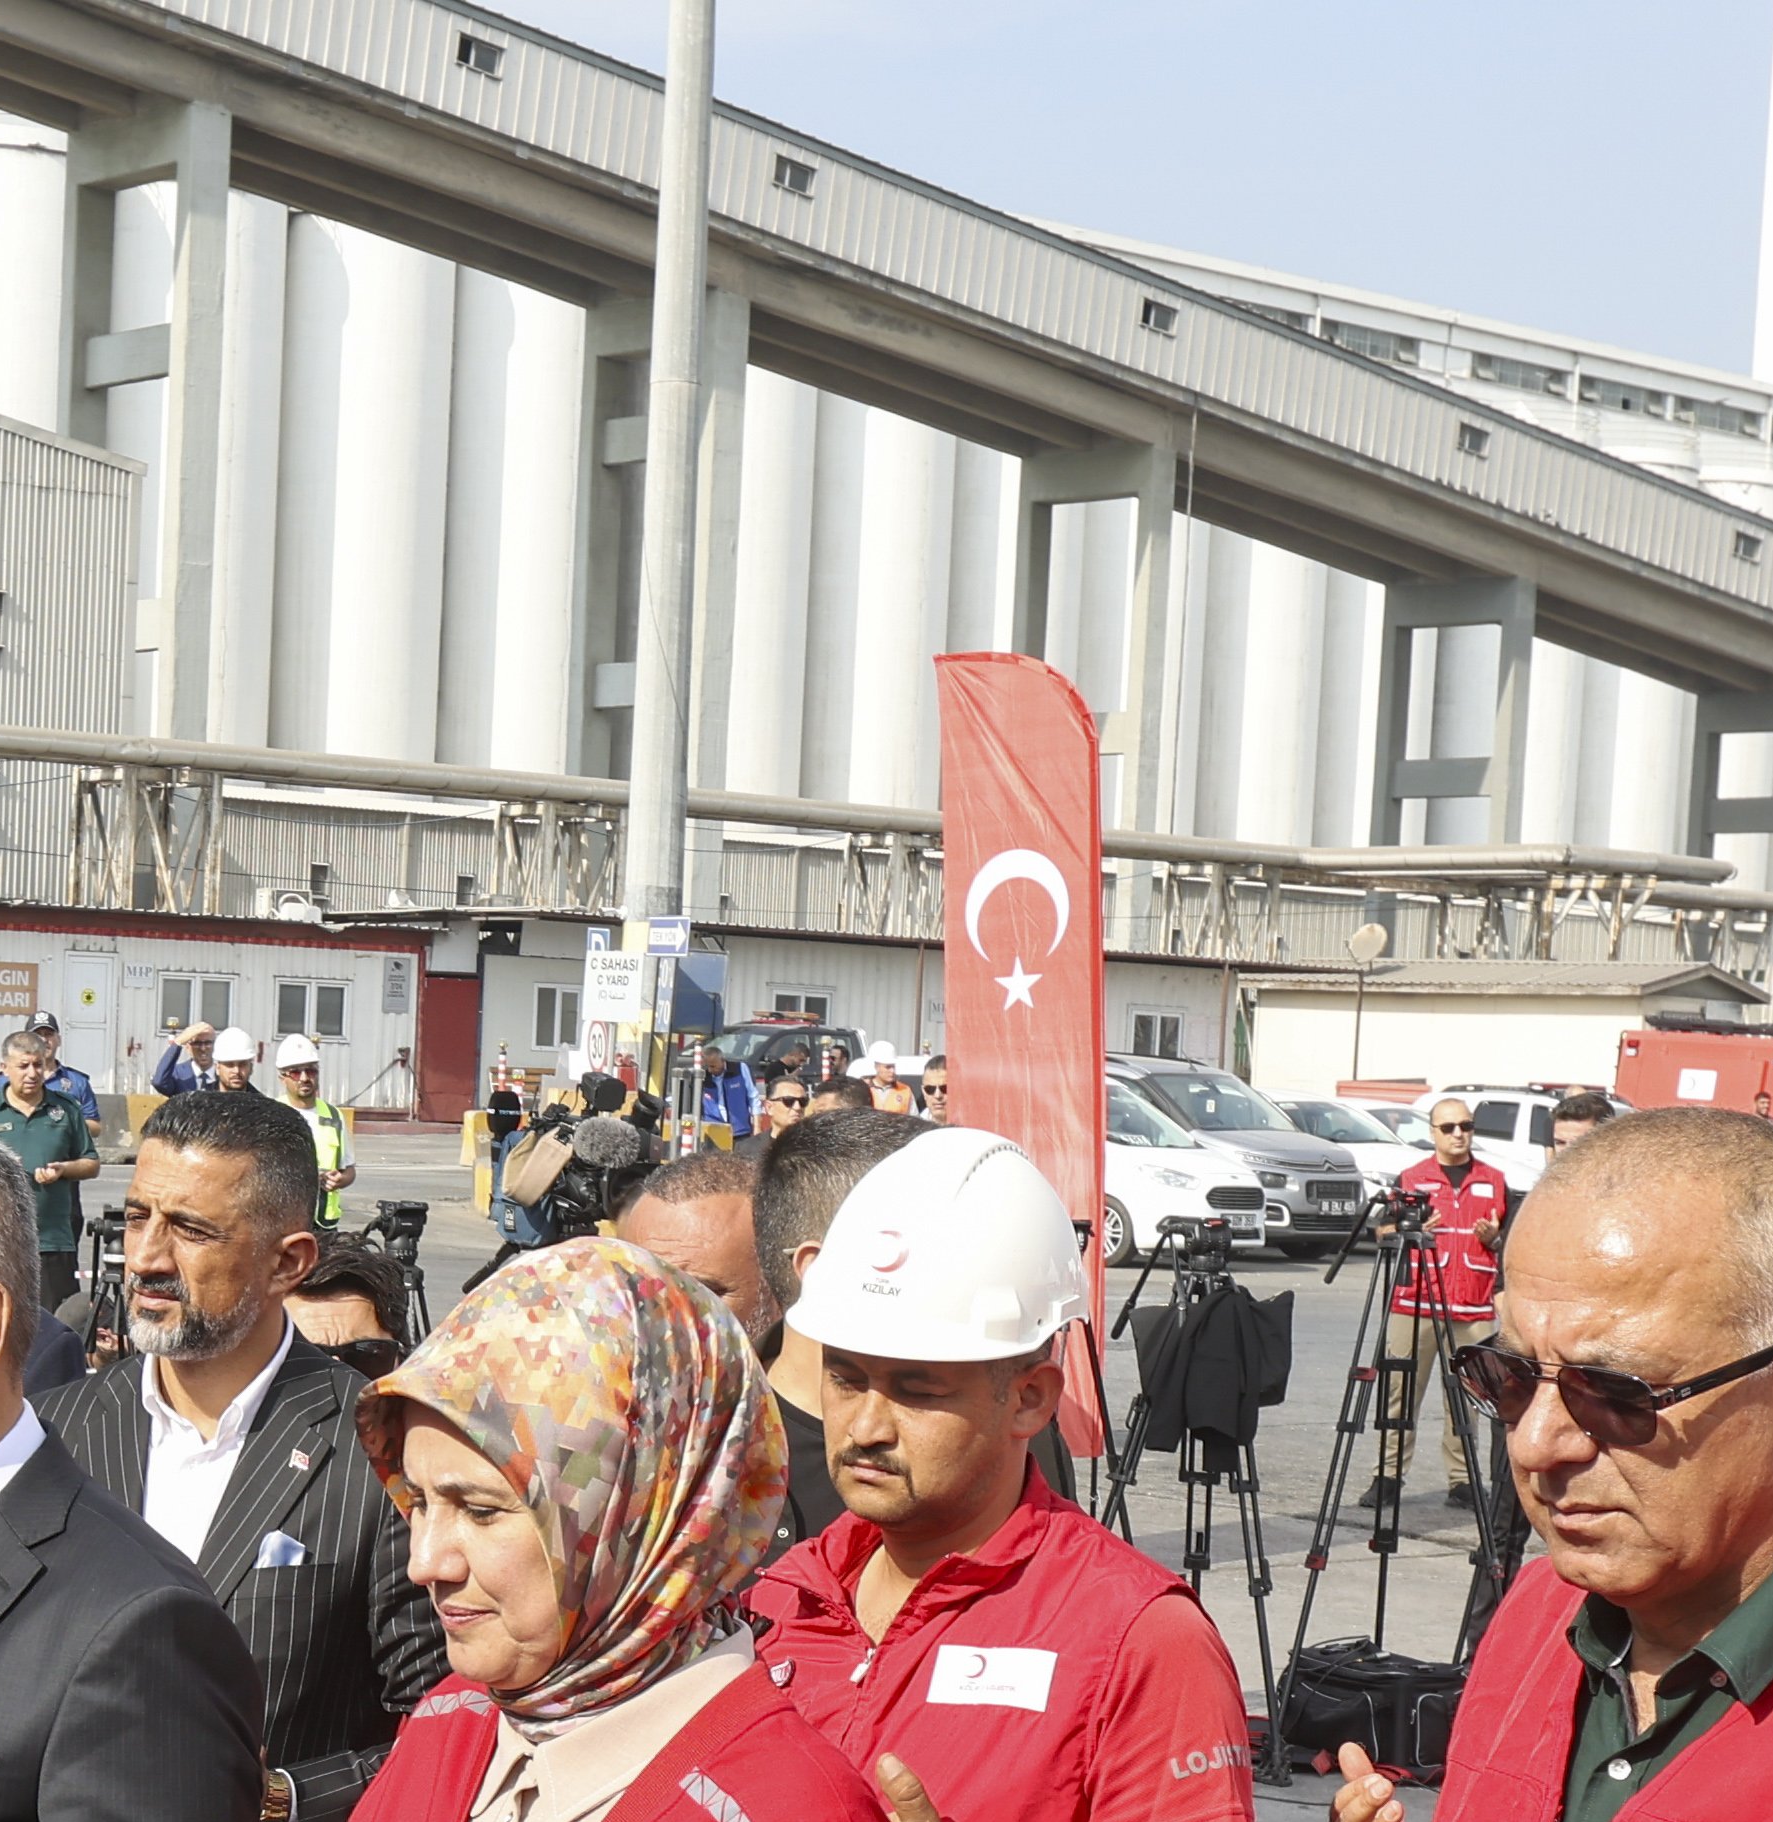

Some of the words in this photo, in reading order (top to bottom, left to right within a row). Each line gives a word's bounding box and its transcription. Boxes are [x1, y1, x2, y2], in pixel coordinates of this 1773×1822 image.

[590, 957, 599, 970] C
[600, 958, 639, 971] SAHASI
[597, 974, 604, 985] C
[606, 975, 630, 986] YARD
[591, 1034, 603, 1059] 30
[862, 1283, 901, 1297] KIZILAY
